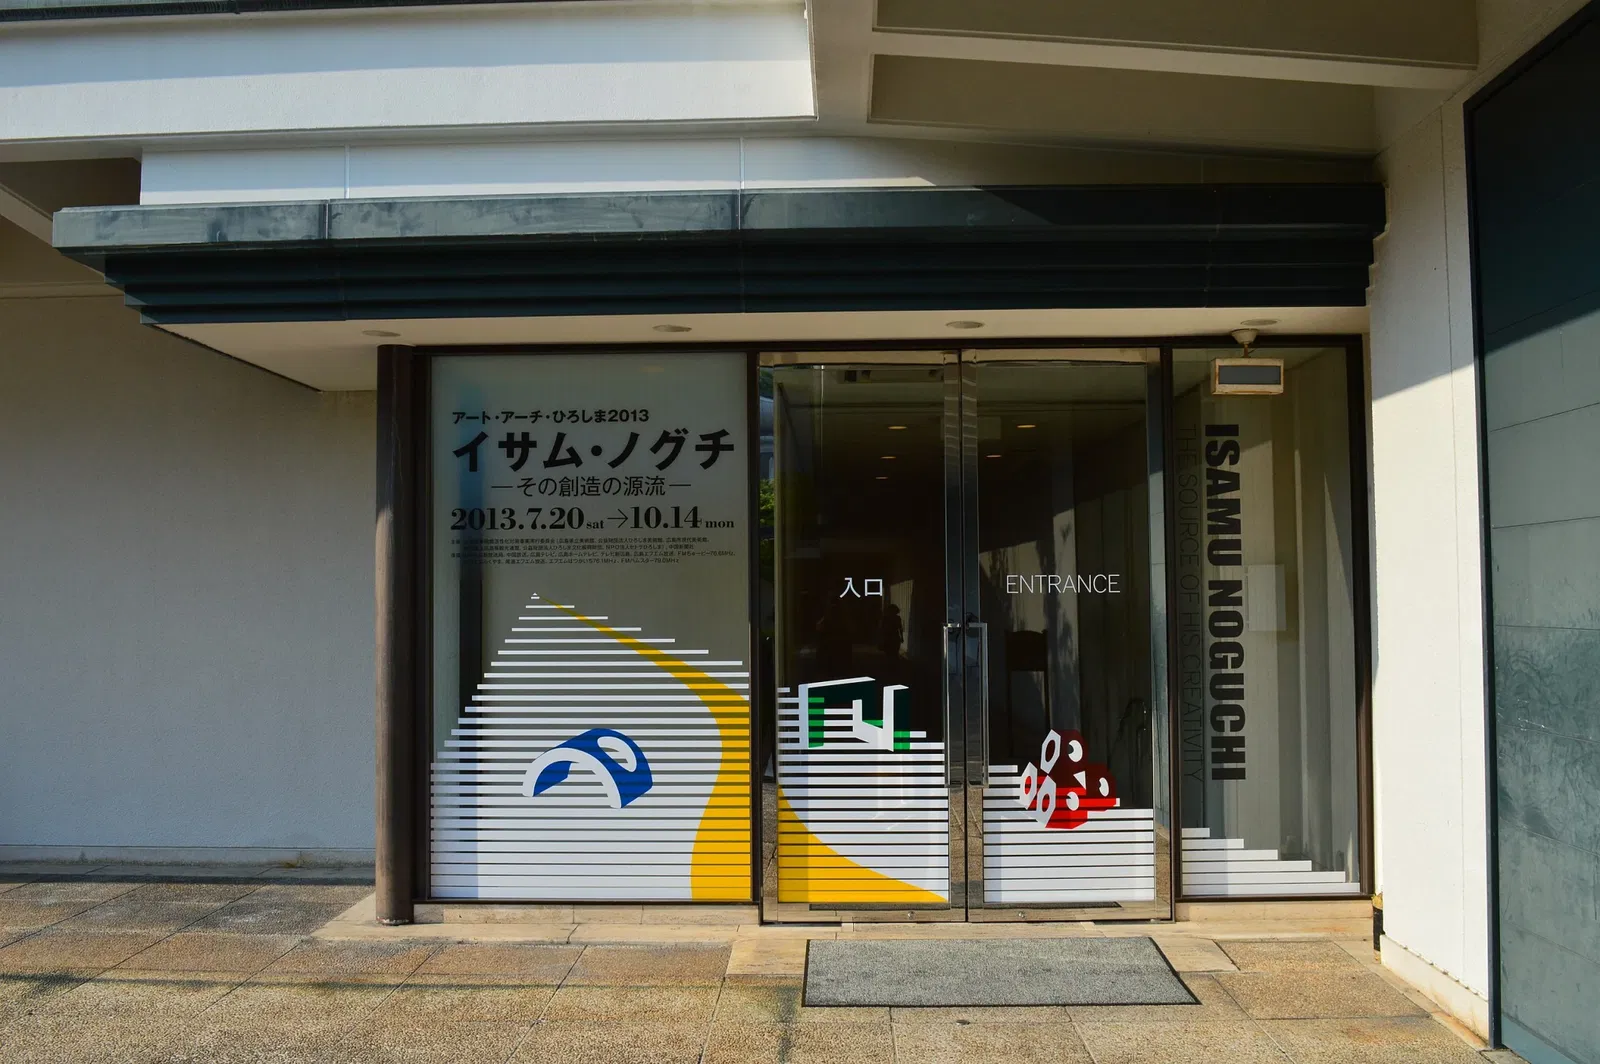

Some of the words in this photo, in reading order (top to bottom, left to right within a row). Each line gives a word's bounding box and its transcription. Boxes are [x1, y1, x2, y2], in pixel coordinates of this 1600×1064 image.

[452, 409, 650, 425] アート・アーチ・ひろしま2013
[453, 428, 735, 473] イサム・ノグチ
[1176, 424, 1197, 471] THE
[1204, 424, 1242, 566] ISAMU
[451, 506, 585, 531] 2013.7.20
[706, 518, 735, 530] mon
[1177, 474, 1199, 568] SOURCE
[838, 576, 885, 599] 入口
[1006, 573, 1121, 595] ENTRANCE
[1179, 574, 1200, 605] OF
[1180, 611, 1201, 647] HIS
[1208, 579, 1247, 781] NOGUCHI
[1181, 652, 1204, 783] CREATIVITY
